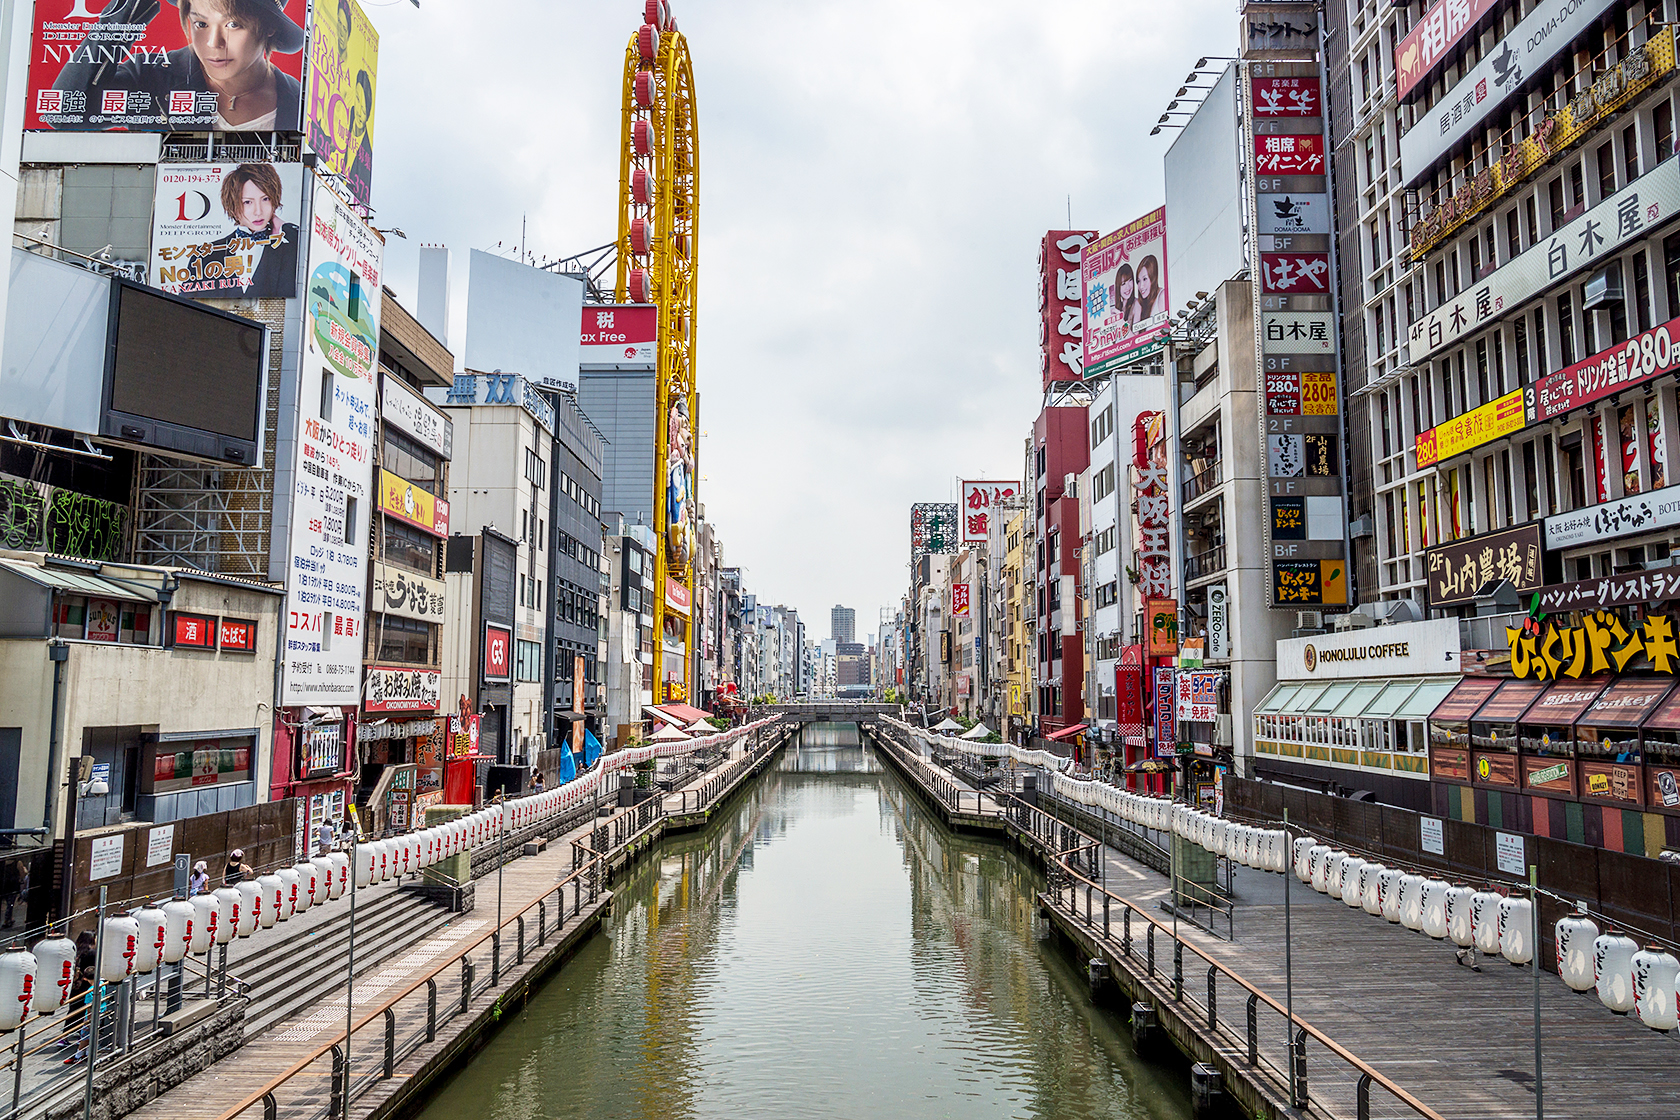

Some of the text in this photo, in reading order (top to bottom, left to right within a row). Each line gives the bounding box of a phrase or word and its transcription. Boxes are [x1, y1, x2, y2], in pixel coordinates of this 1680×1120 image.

[43, 22, 147, 31] Monster Entertainment
[43, 32, 147, 41] DEEP GROUP
[41, 44, 171, 65] NYANNYA
[313, 23, 351, 87] OSAKA
[312, 39, 343, 93] HOST
[36, 90, 219, 115] 最強 最幸 最高
[307, 60, 350, 154] FC
[1440, 92, 1474, 136] 居酒家
[1265, 137, 1295, 152] 相席
[1256, 154, 1324, 172] ダイニング
[163, 175, 221, 183] 0120-194-373
[158, 232, 286, 261] モンスターグループ
[1274, 238, 1292, 249] 5F
[1549, 193, 1644, 281] 白木屋
[1263, 258, 1328, 290] はや
[161, 276, 255, 294] KANZAKI RUKA
[1265, 298, 1287, 309] 4F
[596, 311, 615, 328] 税
[1428, 286, 1493, 350] 白木屋
[580, 331, 627, 342] ax Free
[1267, 319, 1329, 341] 白木屋
[1411, 322, 1425, 341] 4F
[1266, 381, 1299, 393] 280円
[1305, 373, 1332, 383] 全品
[1303, 383, 1336, 402] 280円
[1525, 388, 1536, 422] 3階
[1269, 419, 1293, 431] 2F
[1306, 435, 1317, 443] 2F
[1317, 435, 1329, 476] 山内農場
[303, 460, 329, 482] 中国自動車道
[1274, 481, 1295, 493] 1F
[436, 500, 448, 516] 17:00
[1277, 509, 1300, 519] びっくり
[1133, 460, 1171, 597] 大阪王将
[1276, 518, 1302, 528] ドンキー
[1549, 515, 1591, 536] 大阪 お好み焼
[310, 545, 325, 561] ロッジ
[1274, 544, 1298, 556] B1F
[1430, 552, 1443, 573] 2F
[1440, 541, 1523, 599] 山内農場
[1279, 570, 1316, 586] びっくり
[385, 573, 429, 615] うなぎ
[960, 585, 969, 604] ツルハ
[1278, 586, 1319, 601] ドンキー
[289, 611, 360, 637] コスパ 最高!
[1211, 604, 1222, 632] ZERO
[185, 622, 198, 641] 酒
[221, 625, 246, 644] たばこ
[492, 638, 504, 666] G3
[1319, 642, 1410, 663] HONOLULU COFFEE
[1505, 610, 1680, 681] びっくりドンキ
[291, 661, 355, 674] 予約受付 0868-75-1144
[384, 670, 421, 699] お好み焼
[386, 701, 419, 709] OKONOMIYAKI
[1160, 685, 1172, 721] ダイコク
[1191, 706, 1209, 719] 免税
